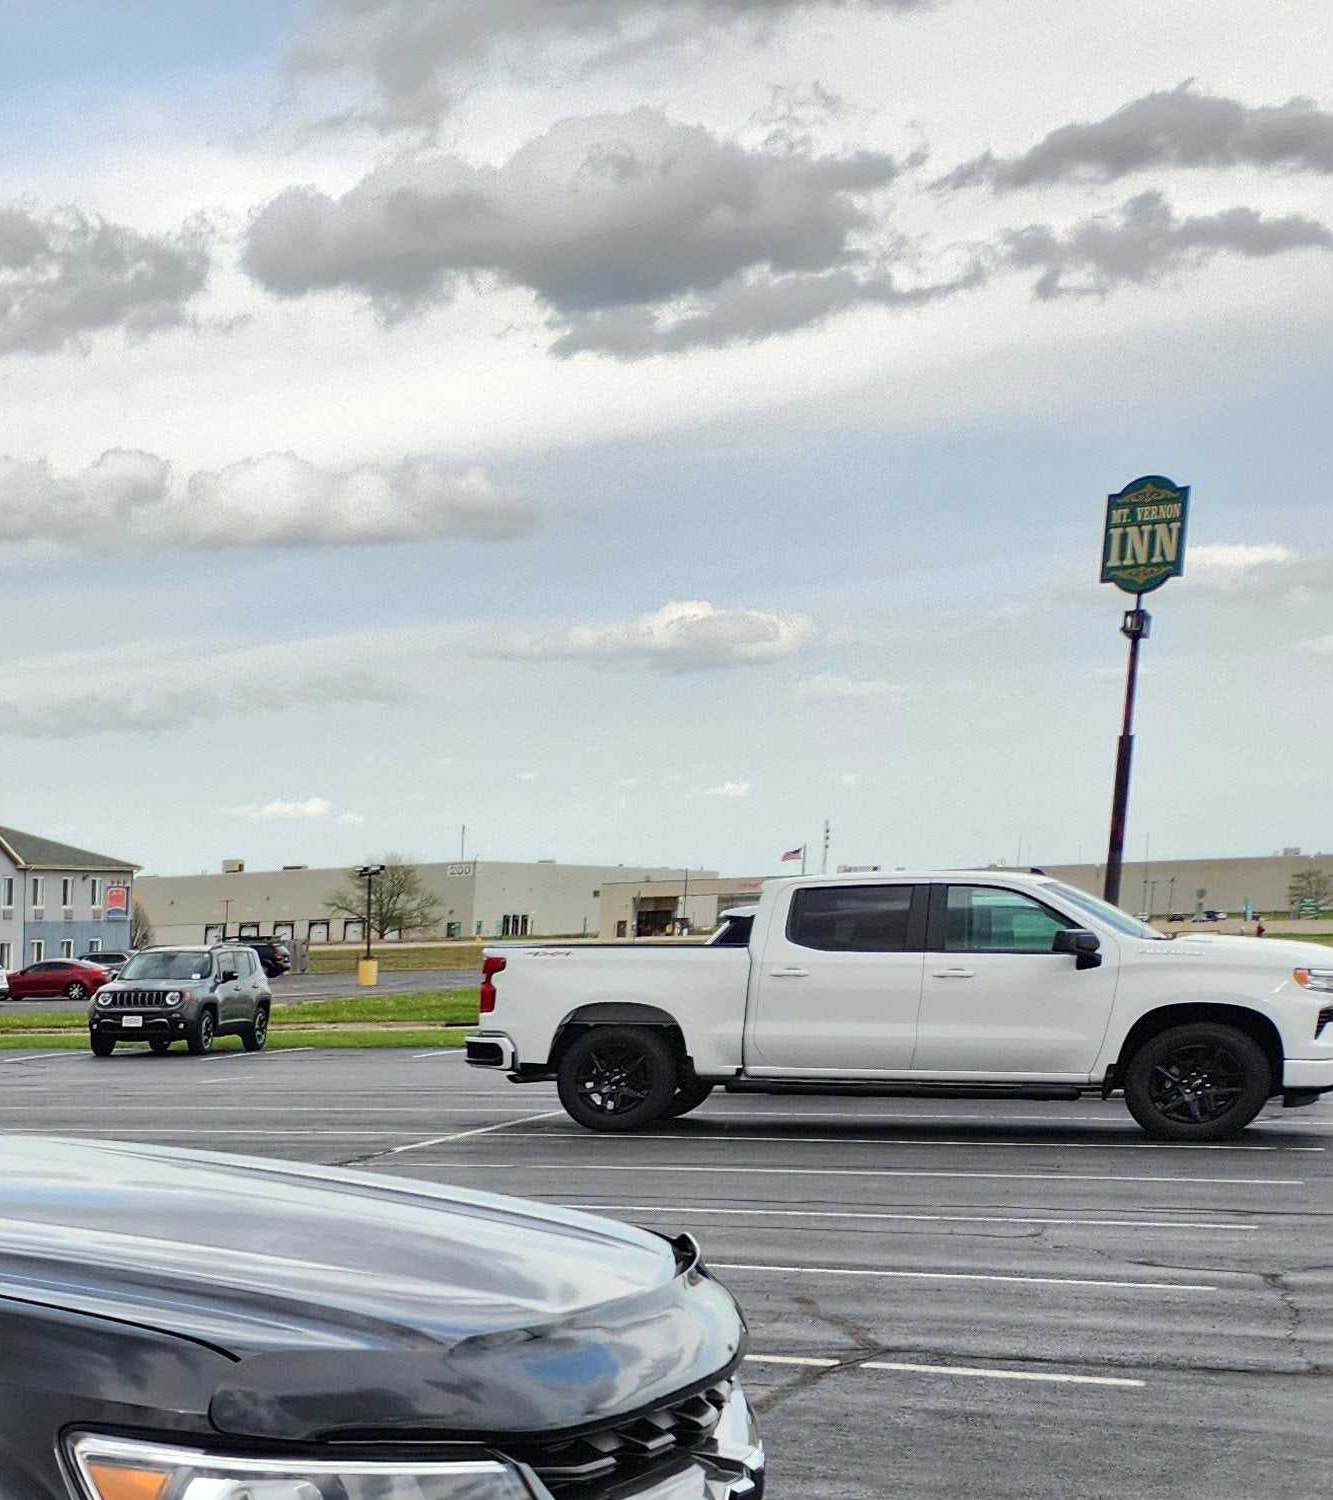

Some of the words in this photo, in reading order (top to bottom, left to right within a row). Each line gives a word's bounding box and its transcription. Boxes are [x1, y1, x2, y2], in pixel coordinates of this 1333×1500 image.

[1111, 509, 1131, 524] MT.
[1136, 503, 1181, 520] VERNON
[1106, 521, 1181, 566] INN
